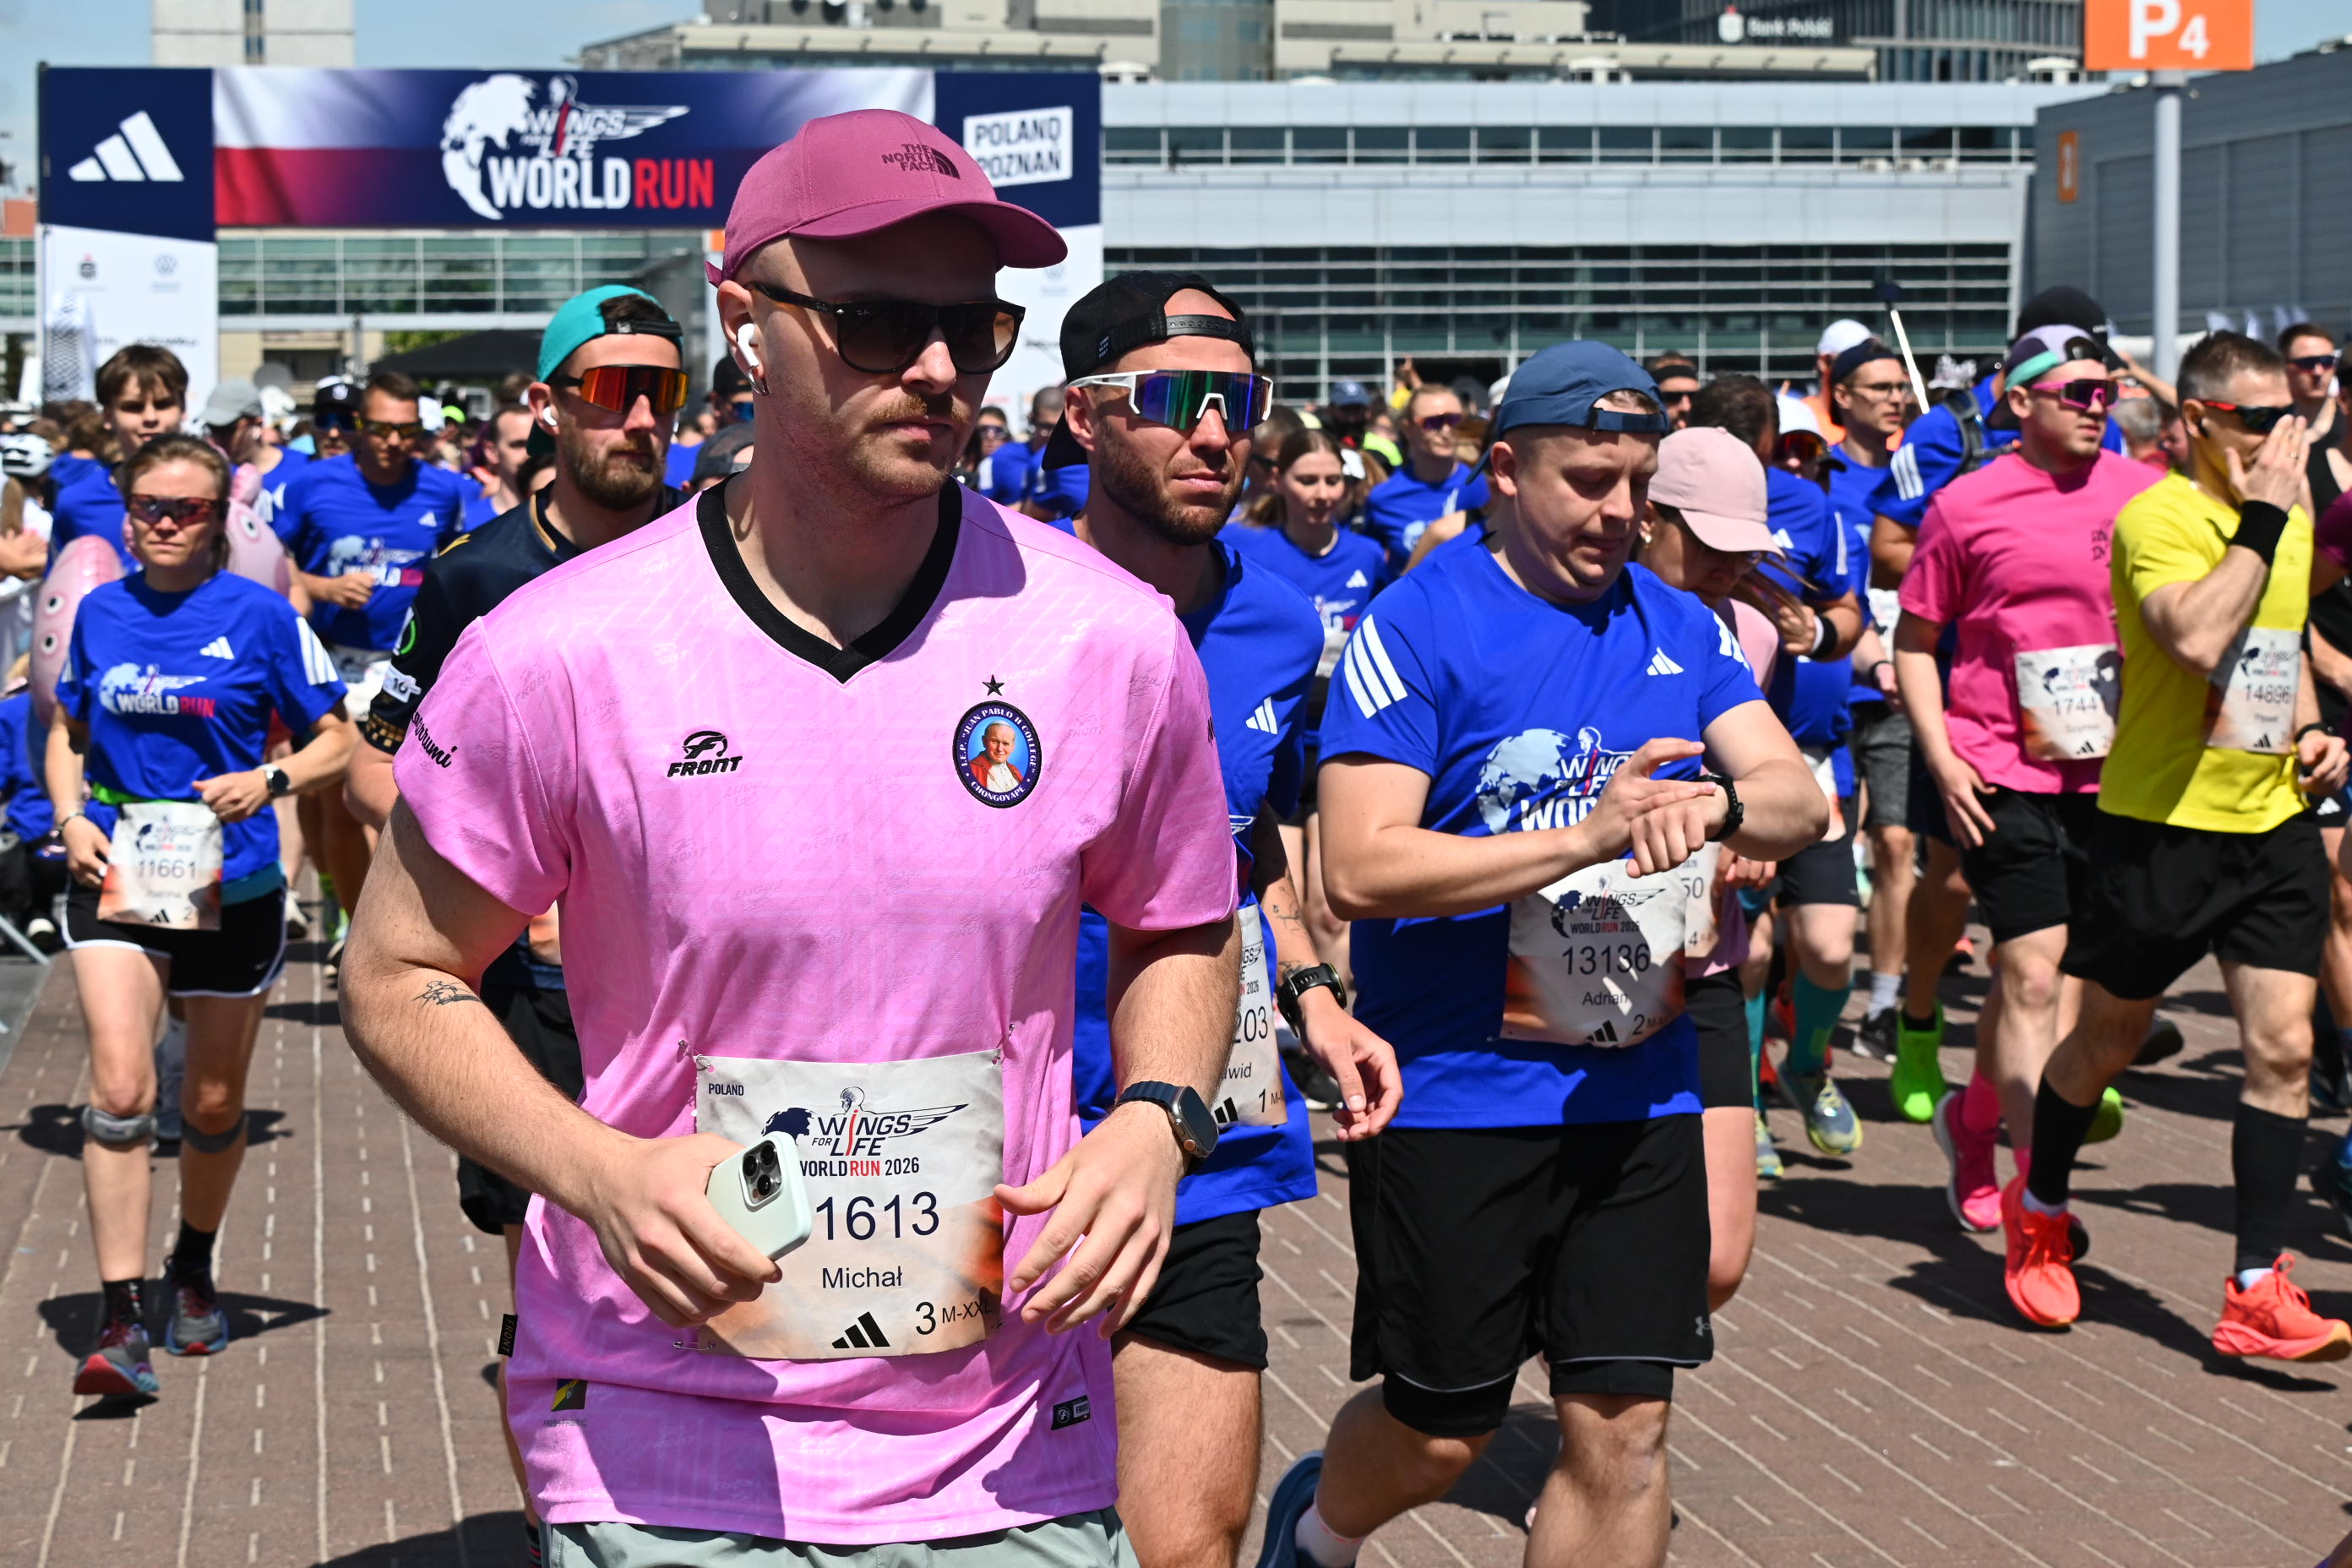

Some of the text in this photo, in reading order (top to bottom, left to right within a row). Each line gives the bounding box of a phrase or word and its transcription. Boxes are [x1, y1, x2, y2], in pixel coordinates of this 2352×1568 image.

[975, 117, 1061, 146] POLAND
[881, 152, 936, 164] NORTH
[901, 144, 931, 154] THE
[900, 161, 938, 172] FACE
[487, 156, 714, 210] WORLD RUN
[117, 692, 216, 717] WORLD RUN
[981, 707, 1014, 719] PABLO
[667, 755, 743, 778] FRONT
[971, 781, 1026, 803] CHONGOYAPE
[139, 858, 196, 879] 11661
[1585, 889, 1636, 906] WINGS
[1592, 906, 1623, 921] LIFE
[1571, 920, 1641, 934] WORLD RUN 2026
[1562, 943, 1651, 976] 13136
[1246, 979, 1260, 995] 2026
[1582, 991, 1628, 1006] Adrian
[1632, 1014, 1646, 1035] 2
[707, 1083, 744, 1097] POLAND
[1258, 1088, 1266, 1113] 1
[817, 1109, 912, 1136] WINGS
[811, 1136, 886, 1157] FOR LIFE
[850, 1160, 880, 1177] RUN
[885, 1157, 920, 1177] 2026
[822, 1266, 903, 1289] Michał
[915, 1298, 993, 1336] 3 M-XXL
[500, 1318, 515, 1353] FRONT
